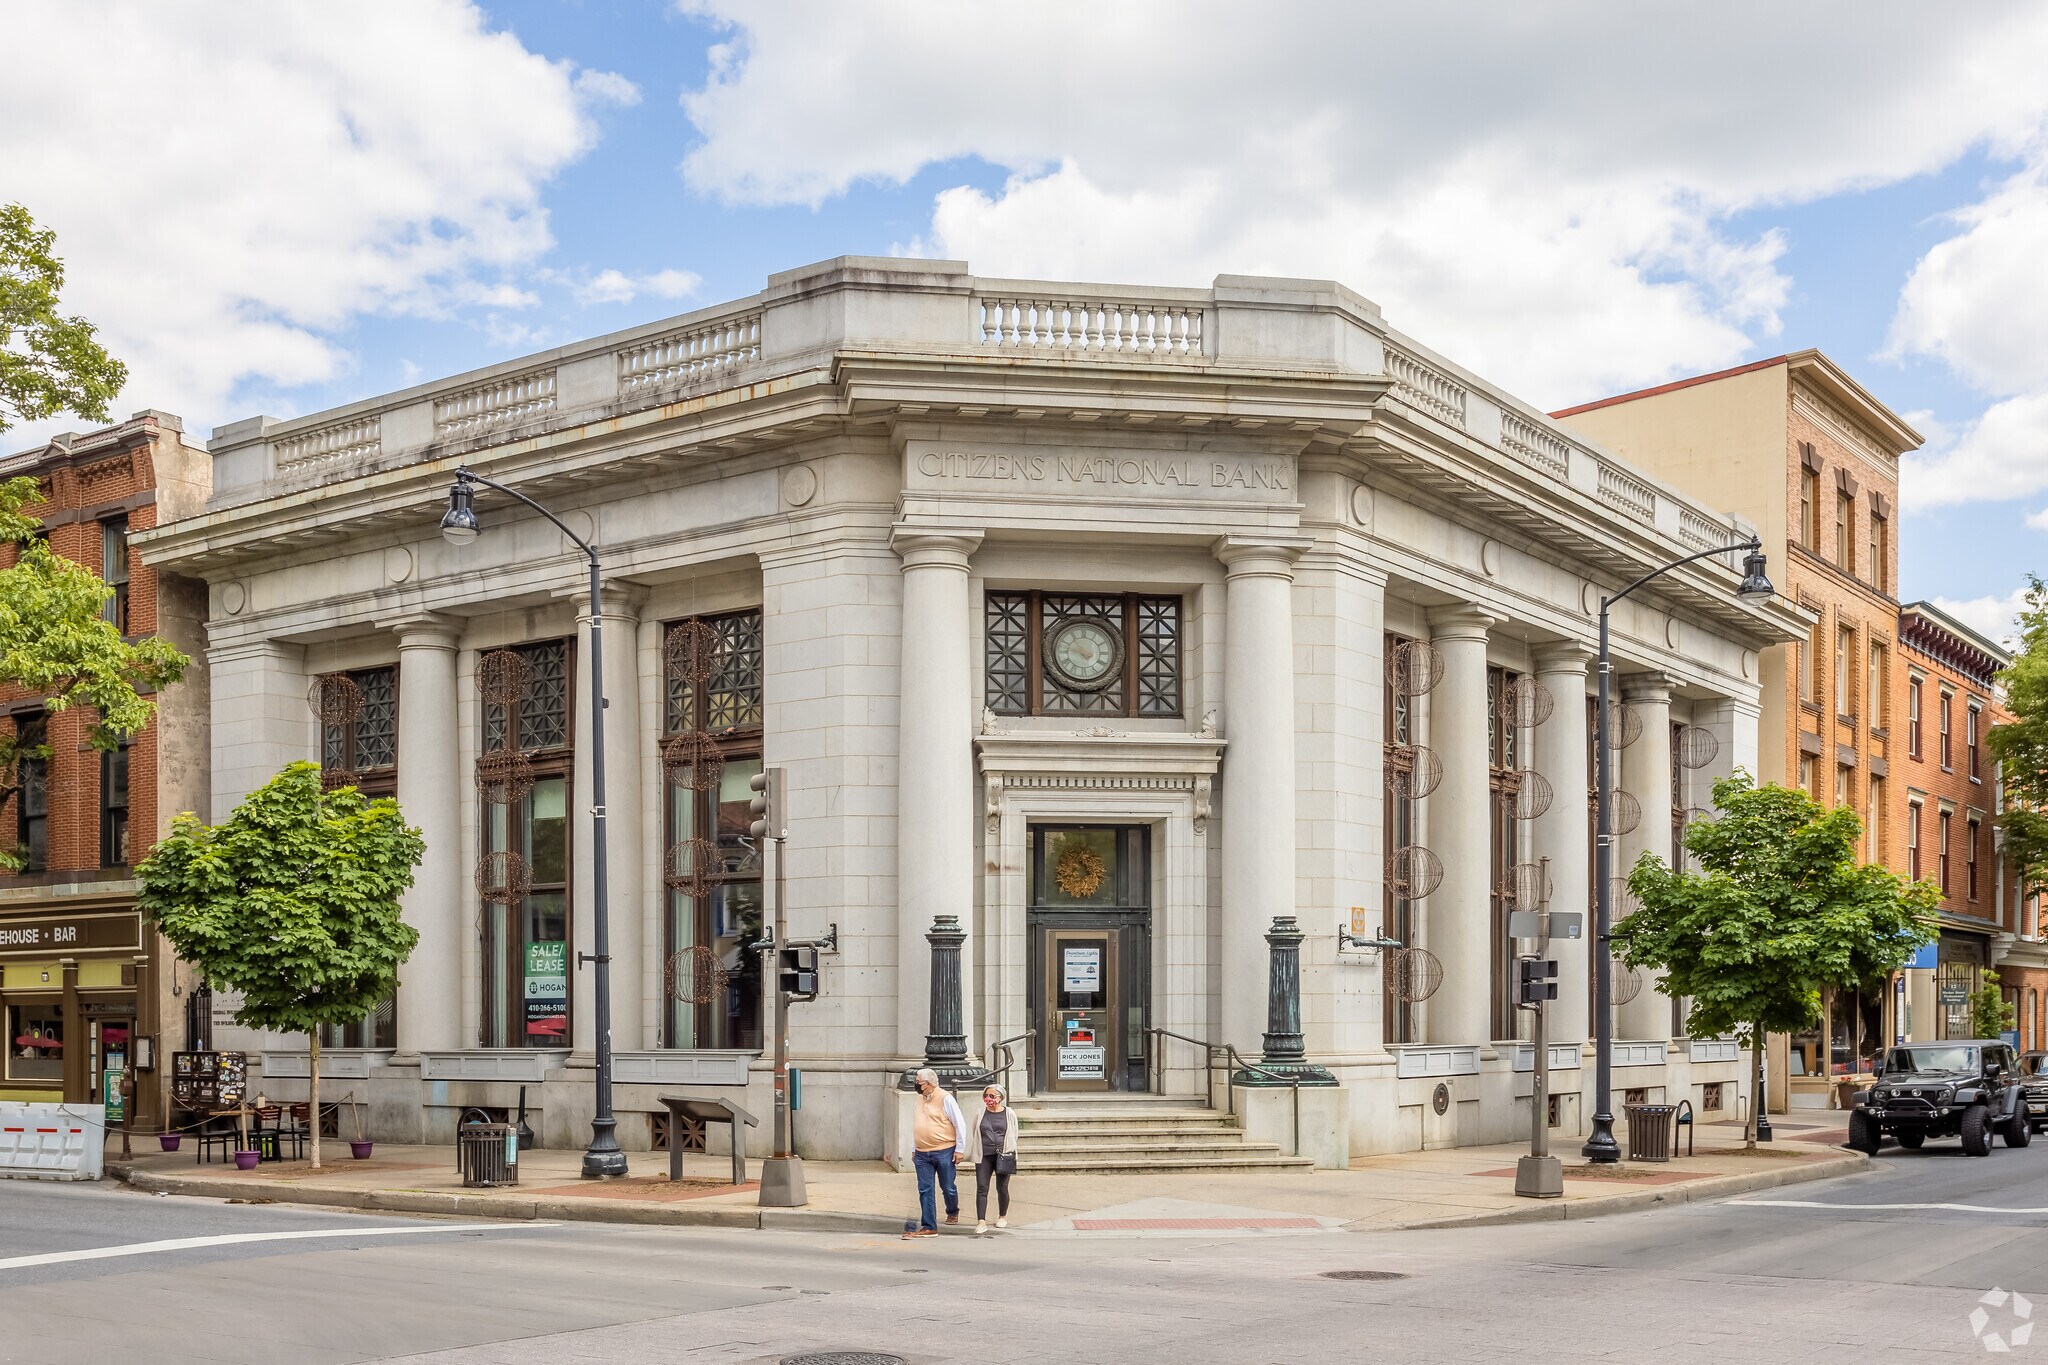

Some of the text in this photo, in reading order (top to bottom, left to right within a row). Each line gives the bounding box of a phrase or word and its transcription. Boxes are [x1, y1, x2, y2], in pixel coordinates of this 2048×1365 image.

[917, 452, 1290, 490] CITIZENS NATIONAL BANK
[0, 926, 76, 945] EHOUSE BAR
[531, 944, 564, 957] SALE/
[530, 959, 565, 972] LEASE
[539, 984, 566, 992] HOGAN
